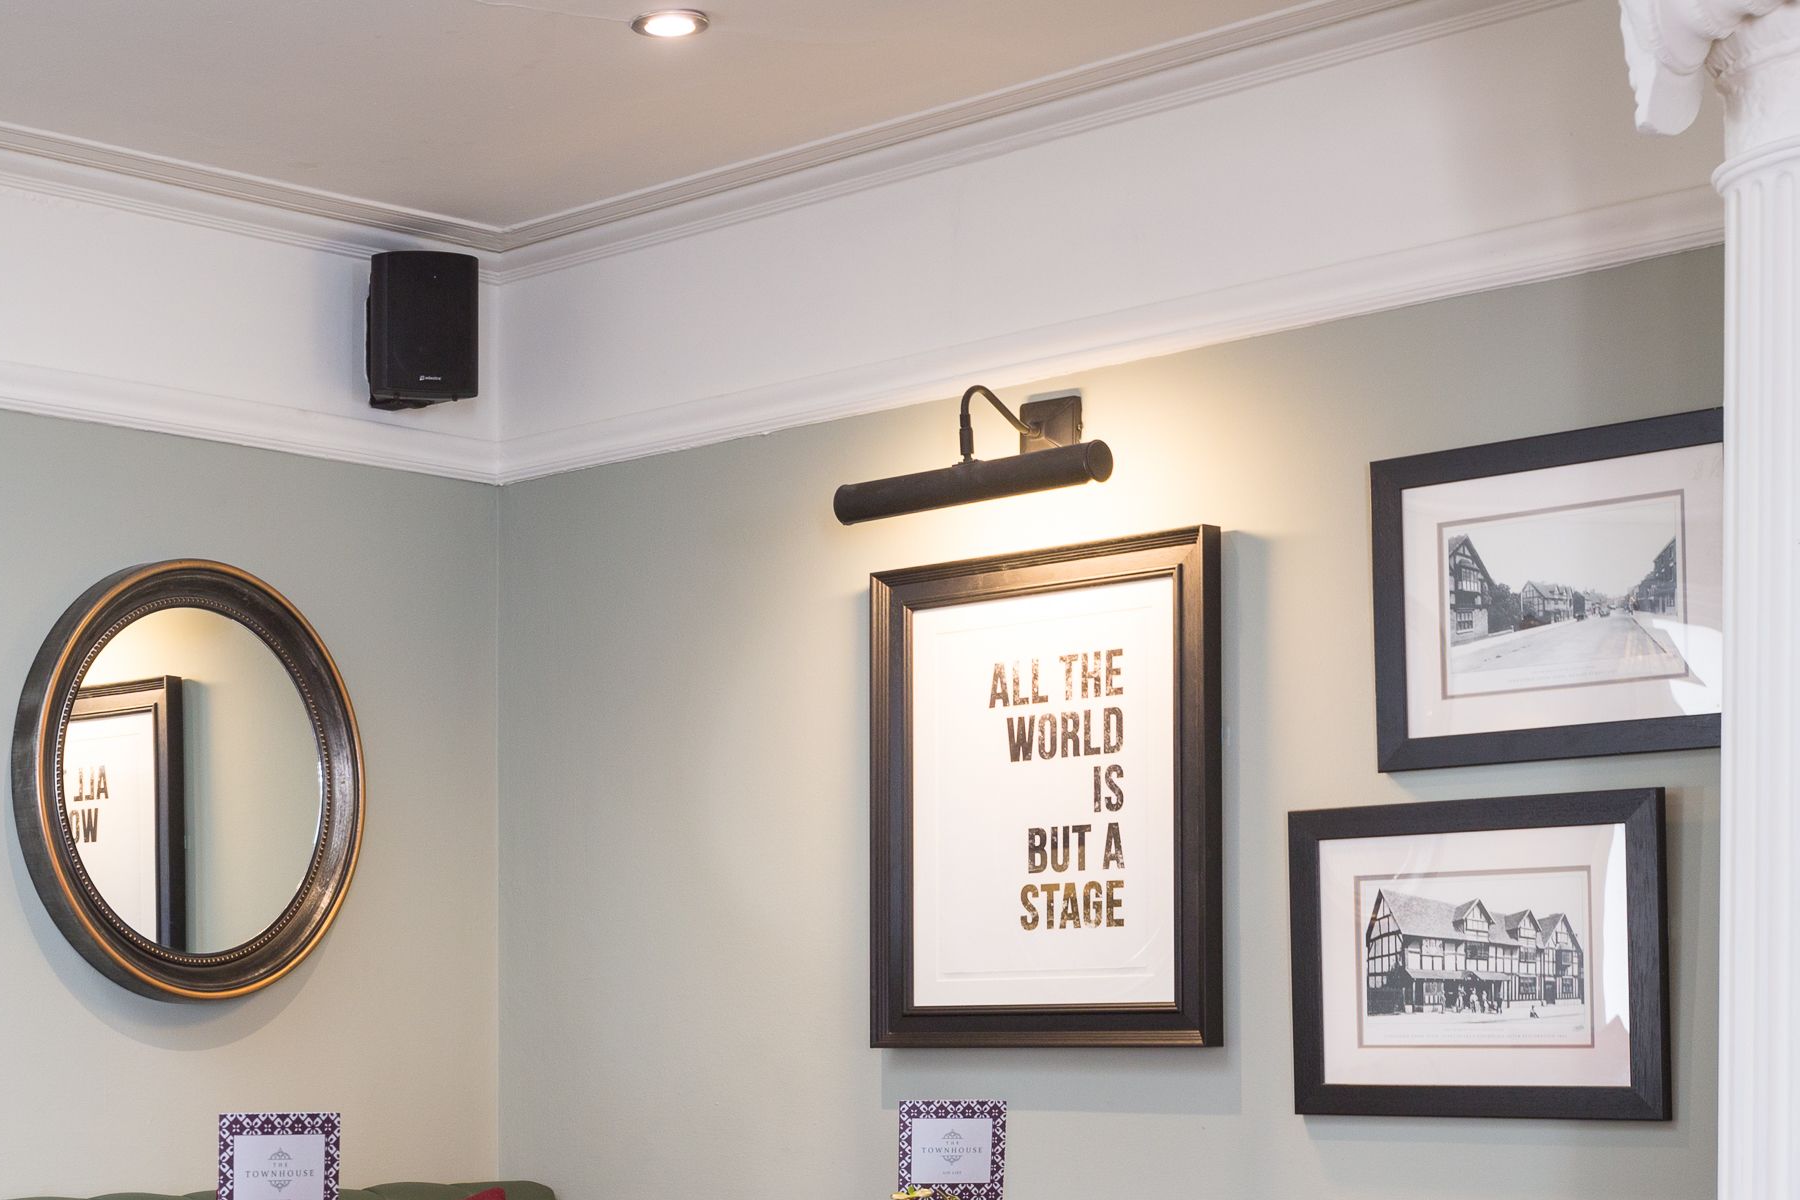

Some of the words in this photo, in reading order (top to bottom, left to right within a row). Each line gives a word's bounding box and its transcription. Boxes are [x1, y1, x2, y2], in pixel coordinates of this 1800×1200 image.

[988, 658, 1049, 709] ALL
[1058, 648, 1124, 701] THE
[1006, 706, 1124, 763] WORLD
[1093, 763, 1125, 813] IS
[1027, 824, 1092, 874] BUT
[1102, 821, 1126, 870] A
[1019, 879, 1125, 931] STAGE
[245, 1169, 315, 1178] TOWNHOUSE
[921, 1146, 983, 1154] TOWNHOUSE
